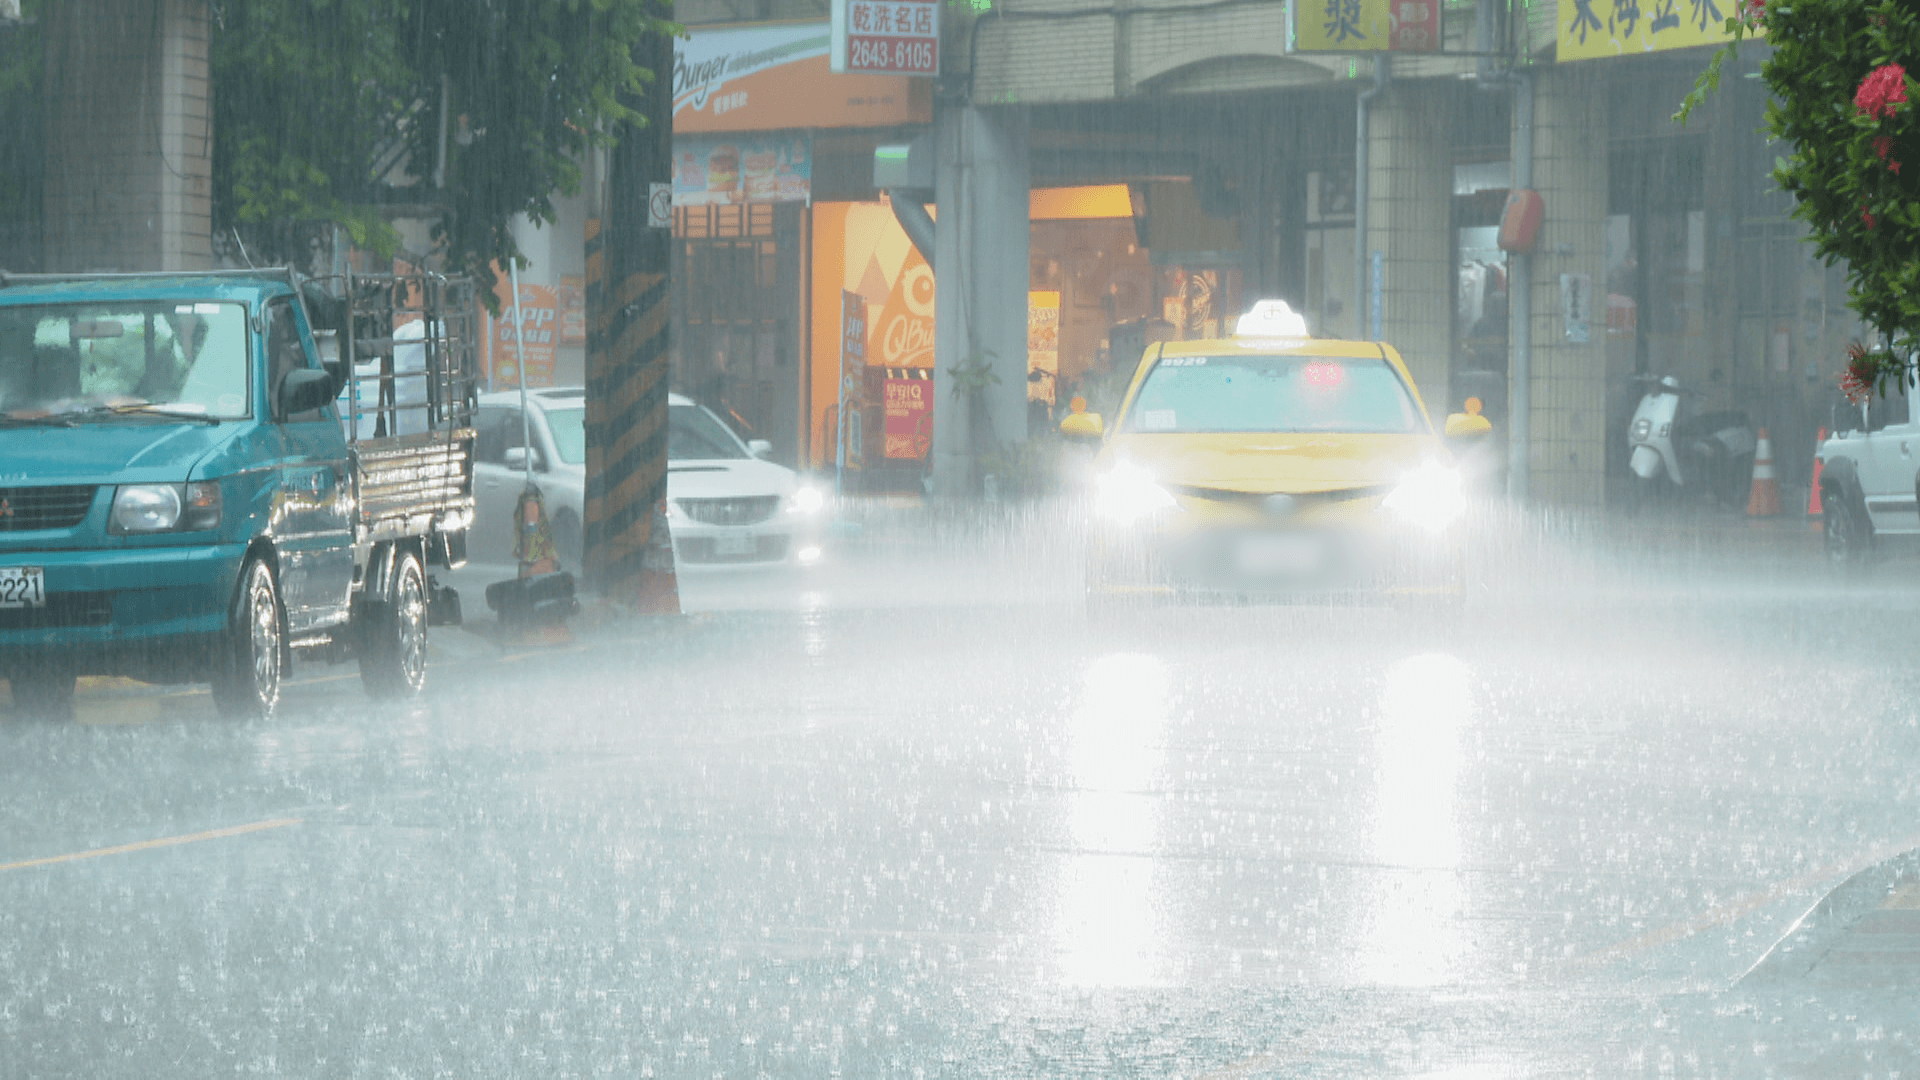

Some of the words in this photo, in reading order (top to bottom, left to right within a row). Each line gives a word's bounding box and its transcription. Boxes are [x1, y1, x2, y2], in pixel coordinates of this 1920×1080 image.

[853, 3, 933, 34] 乾洗名店
[0, 576, 40, 603] 221
